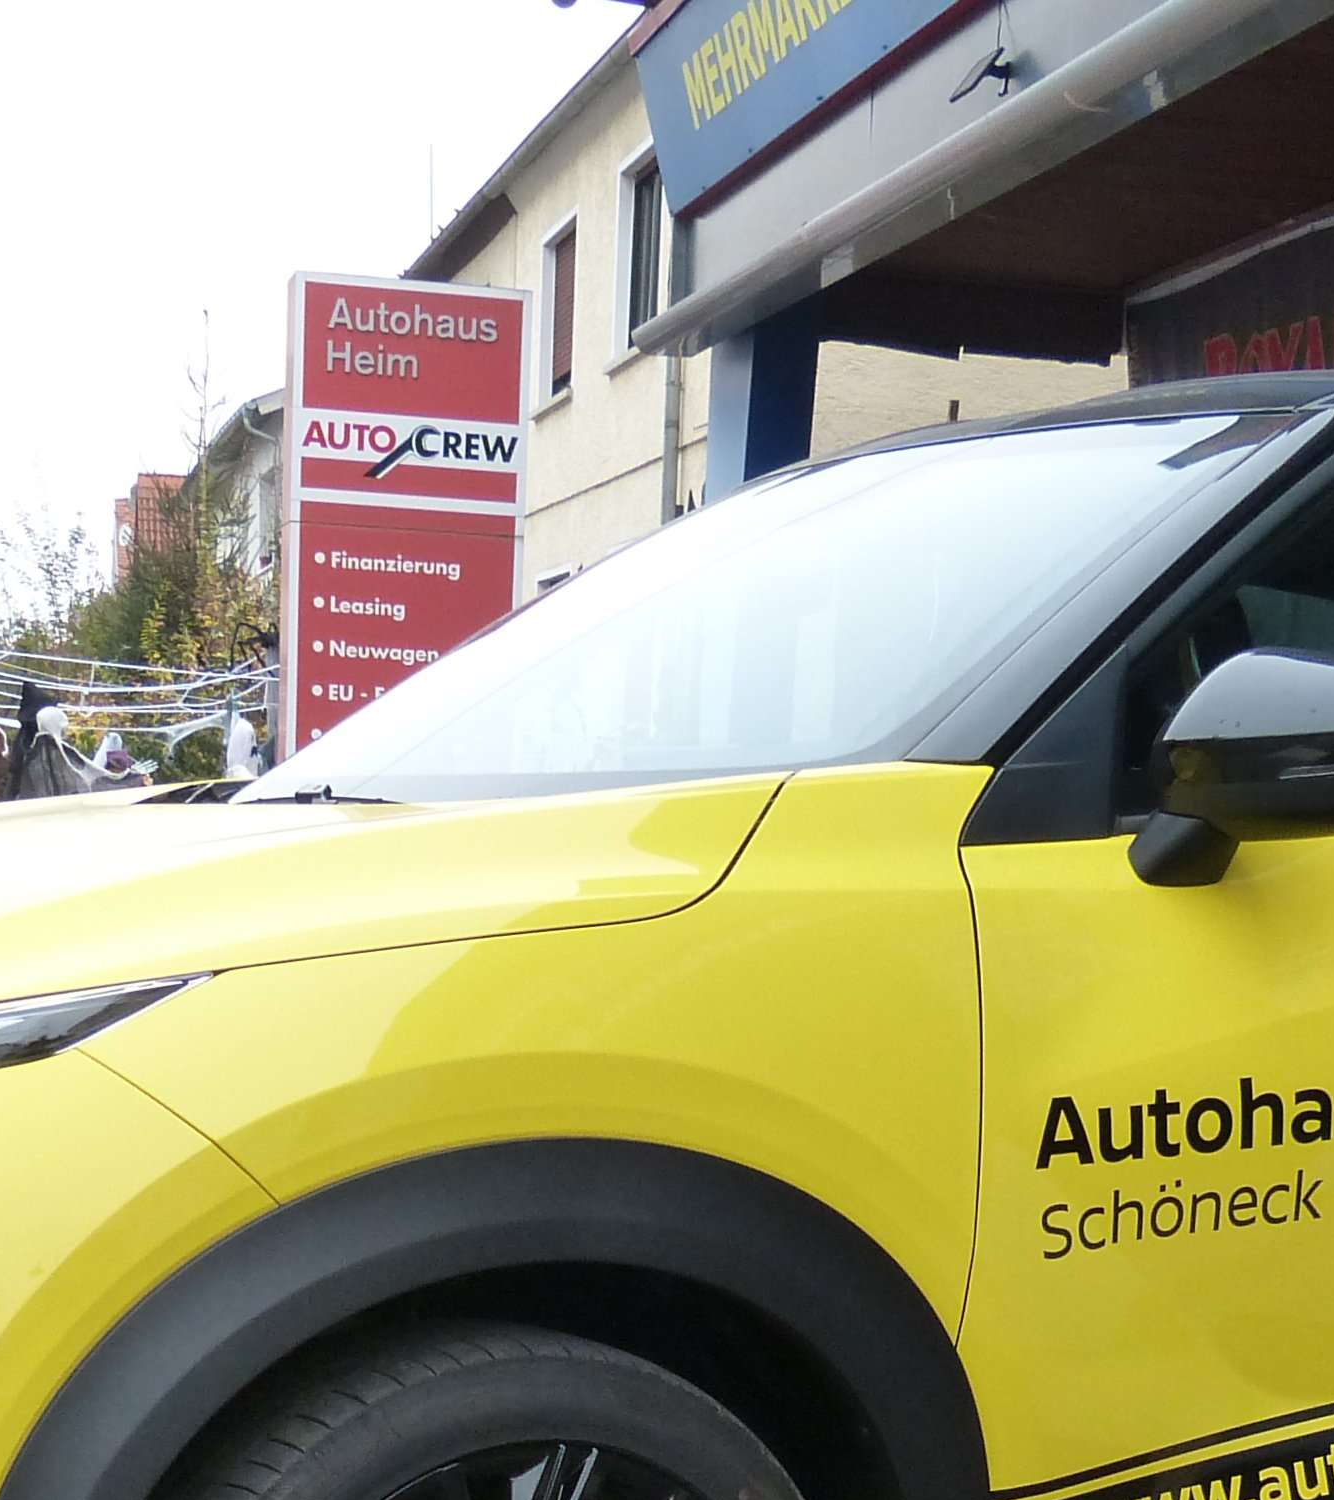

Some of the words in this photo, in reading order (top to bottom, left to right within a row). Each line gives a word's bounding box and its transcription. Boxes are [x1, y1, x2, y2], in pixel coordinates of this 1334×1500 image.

[682, 0, 853, 131] MEHRMAR
[328, 297, 500, 343] Autohaus
[326, 339, 419, 379] Heim
[303, 420, 397, 453] AUTO
[414, 426, 518, 463] CREW
[330, 551, 461, 580] Finanzierung
[329, 595, 406, 621] Leasing
[328, 640, 439, 665] Neuwagen
[328, 684, 354, 701] EU
[1041, 1168, 1324, 1260] Schöneck
